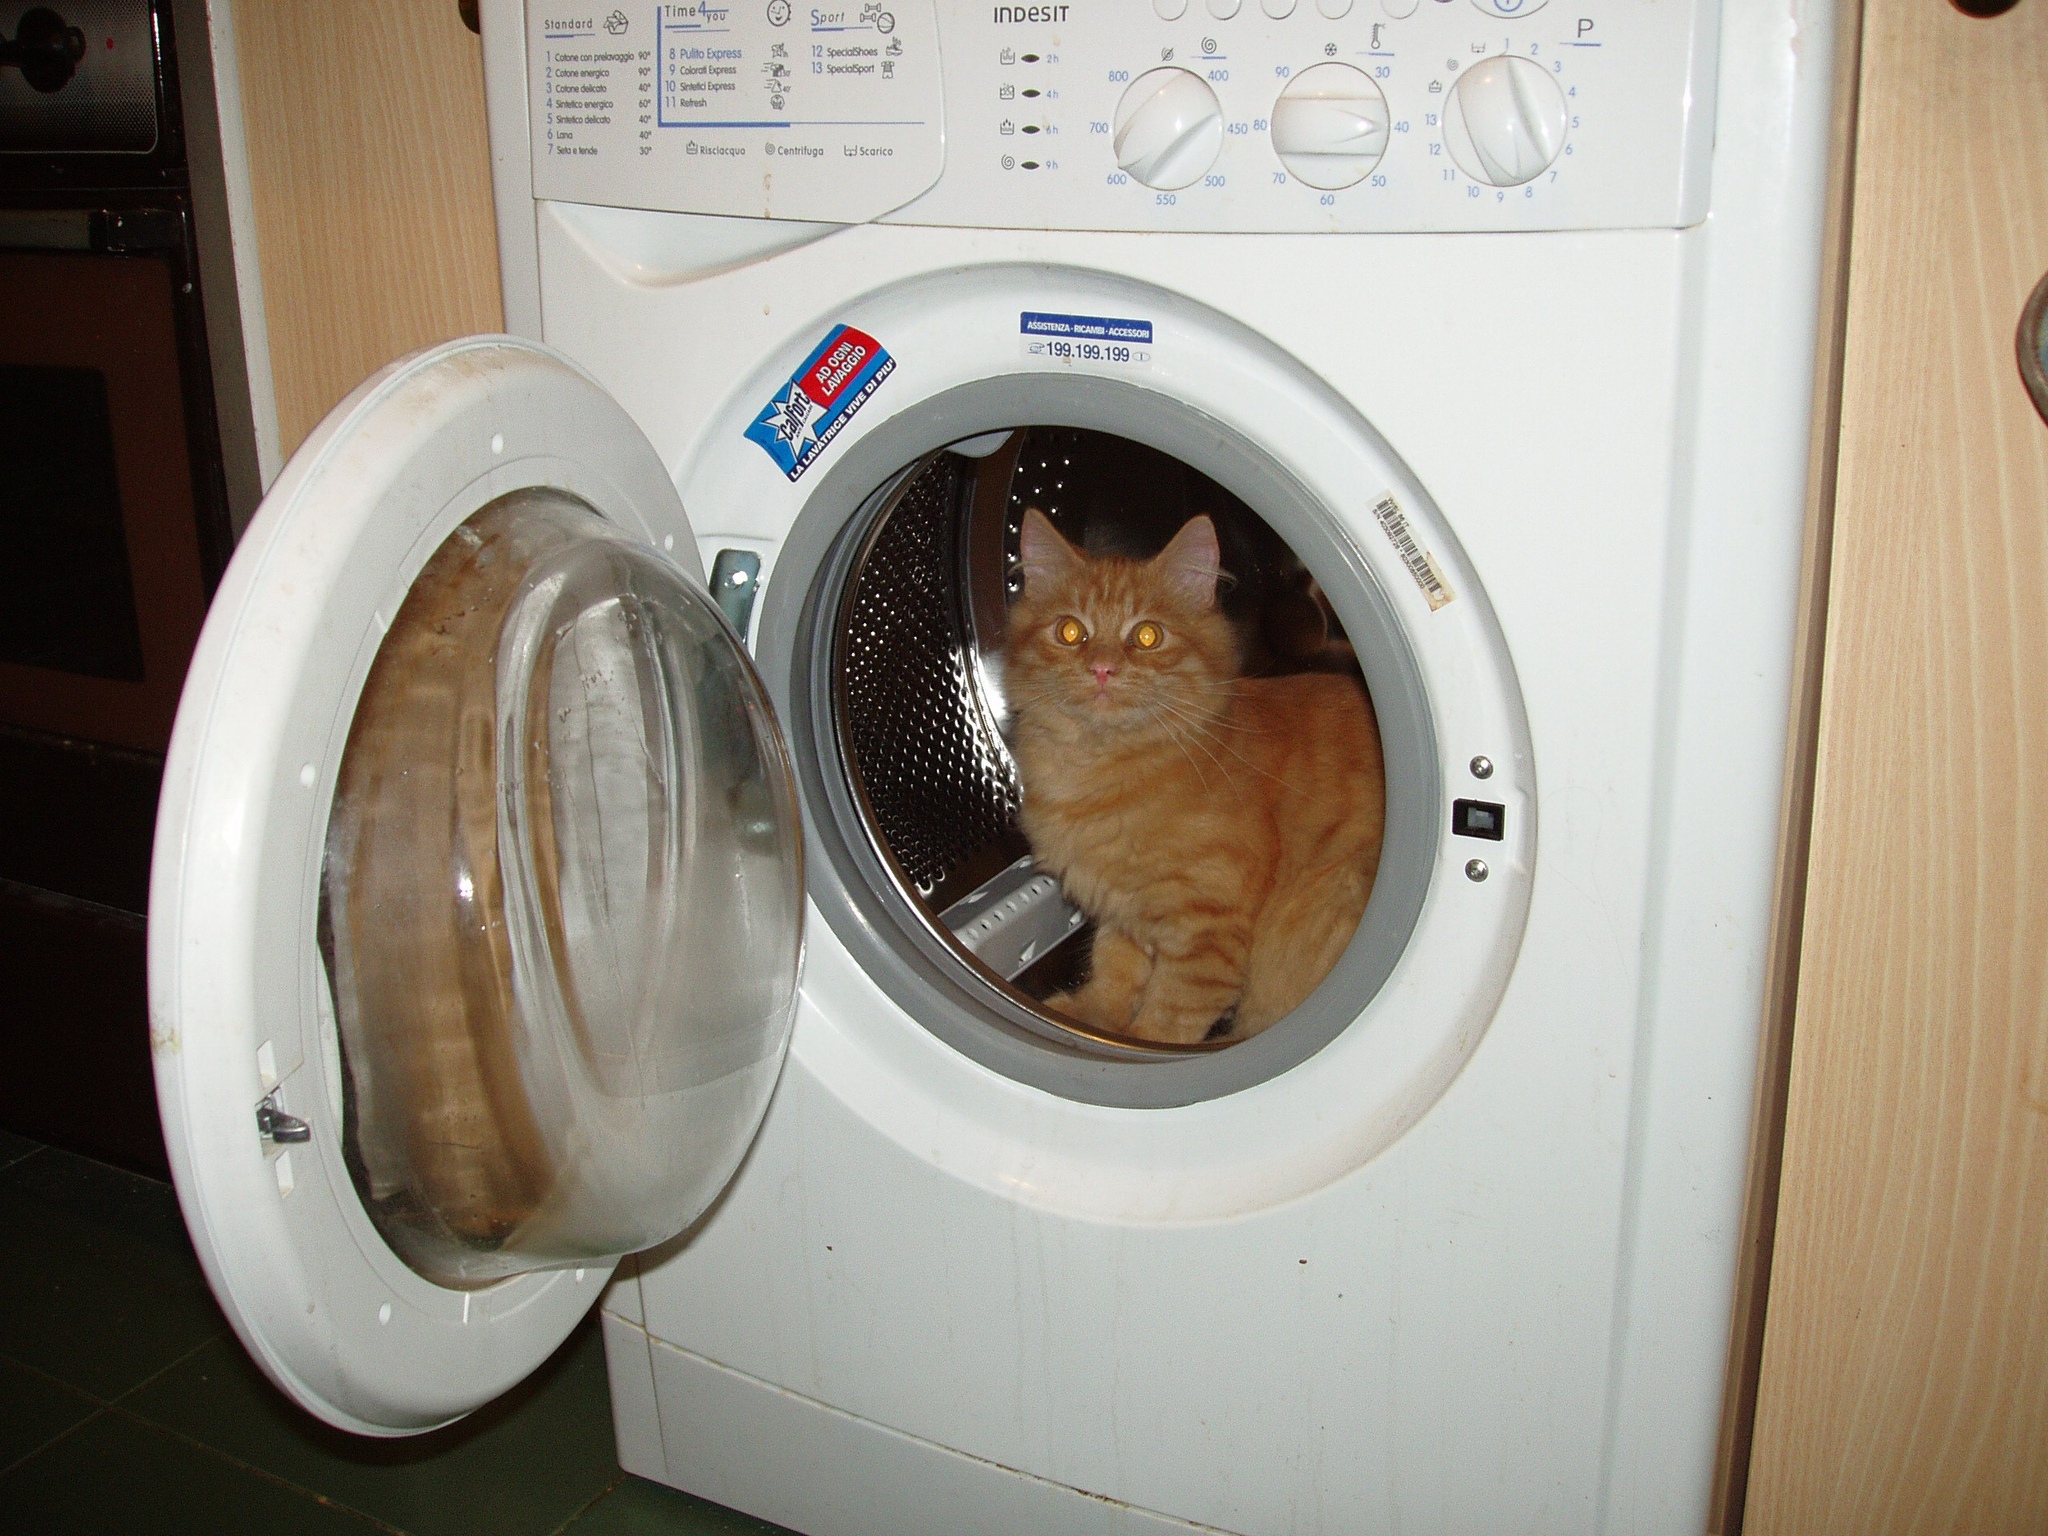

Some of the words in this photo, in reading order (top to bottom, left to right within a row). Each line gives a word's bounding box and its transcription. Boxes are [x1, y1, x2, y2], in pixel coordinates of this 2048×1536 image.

[665, 5, 696, 17] Time
[706, 12, 726, 23] you
[811, 9, 845, 26] Sport
[544, 18, 593, 29] Standard
[1577, 18, 1594, 38] P
[669, 48, 675, 60] 8
[680, 48, 705, 59] Pulito
[707, 48, 742, 61] Express
[812, 45, 823, 58] 12
[827, 46, 878, 59] SpecialShoes
[1531, 43, 1539, 55] 2
[555, 53, 579, 62] Cotone
[580, 54, 592, 62] con
[594, 51, 634, 63] prelavaggio
[546, 67, 552, 78] 2
[555, 69, 579, 78] Cotone
[580, 69, 610, 79] energico
[669, 64, 675, 75] 9
[680, 65, 707, 75] Colorati
[709, 65, 737, 76] Express
[812, 62, 823, 74] 13
[827, 63, 875, 76] SpecialSport
[1275, 66, 1290, 78] 90
[1375, 66, 1390, 78] 30
[1554, 61, 1562, 73] 3
[1108, 70, 1129, 82] 800
[1208, 70, 1229, 81] 400
[546, 82, 552, 93] 3
[555, 84, 579, 93] Cotone
[580, 83, 607, 93] delicato
[665, 80, 676, 92] 10
[680, 82, 706, 92] Sintetici
[708, 82, 736, 92] Express
[1568, 87, 1576, 97] 4
[546, 98, 552, 108] 4
[556, 99, 583, 108] Sintetico
[584, 100, 613, 110] energico
[665, 96, 676, 107] 11
[680, 98, 707, 107] Refresh
[547, 113, 553, 124] 5
[556, 115, 583, 124] Sintetico
[584, 115, 611, 124] delicato
[1425, 114, 1437, 126] 13
[1572, 116, 1579, 128] 5
[1089, 122, 1109, 133] 700
[1227, 123, 1248, 135] 450
[1253, 119, 1267, 131] 80
[1394, 121, 1409, 133] 40
[547, 129, 553, 139] 6
[556, 131, 573, 139] Lana
[547, 144, 553, 155] 7
[556, 146, 571, 155] Seta
[578, 146, 598, 155] tende
[699, 144, 746, 157] Risciacquo
[777, 145, 824, 157] Centrifuga
[859, 146, 893, 156] Scarico
[1429, 144, 1441, 155] 12
[1565, 144, 1573, 155] 6
[1107, 174, 1127, 185] 600
[1204, 175, 1225, 187] 500
[1272, 172, 1286, 184] 70
[1371, 175, 1386, 187] 50
[1443, 169, 1455, 181] 11
[1550, 171, 1558, 183] 7
[1467, 186, 1480, 198] 10
[1497, 191, 1504, 203] 9
[1525, 186, 1533, 198] 8
[1155, 194, 1176, 206] 550
[1320, 194, 1335, 206] 60
[1027, 321, 1070, 332] ASSISTENZA
[1074, 324, 1105, 335] RICAMBI
[1108, 327, 1150, 338] ACCESSORI
[1047, 341, 1130, 363] 199.199.199
[815, 365, 832, 384] AD
[827, 341, 854, 367] OGNI
[821, 345, 866, 396] LAVAGGIO
[780, 391, 810, 441] Calfort
[790, 462, 804, 479] LA
[802, 414, 848, 465] LAVATRICE
[845, 391, 867, 415] VIVE
[865, 381, 878, 393] DI
